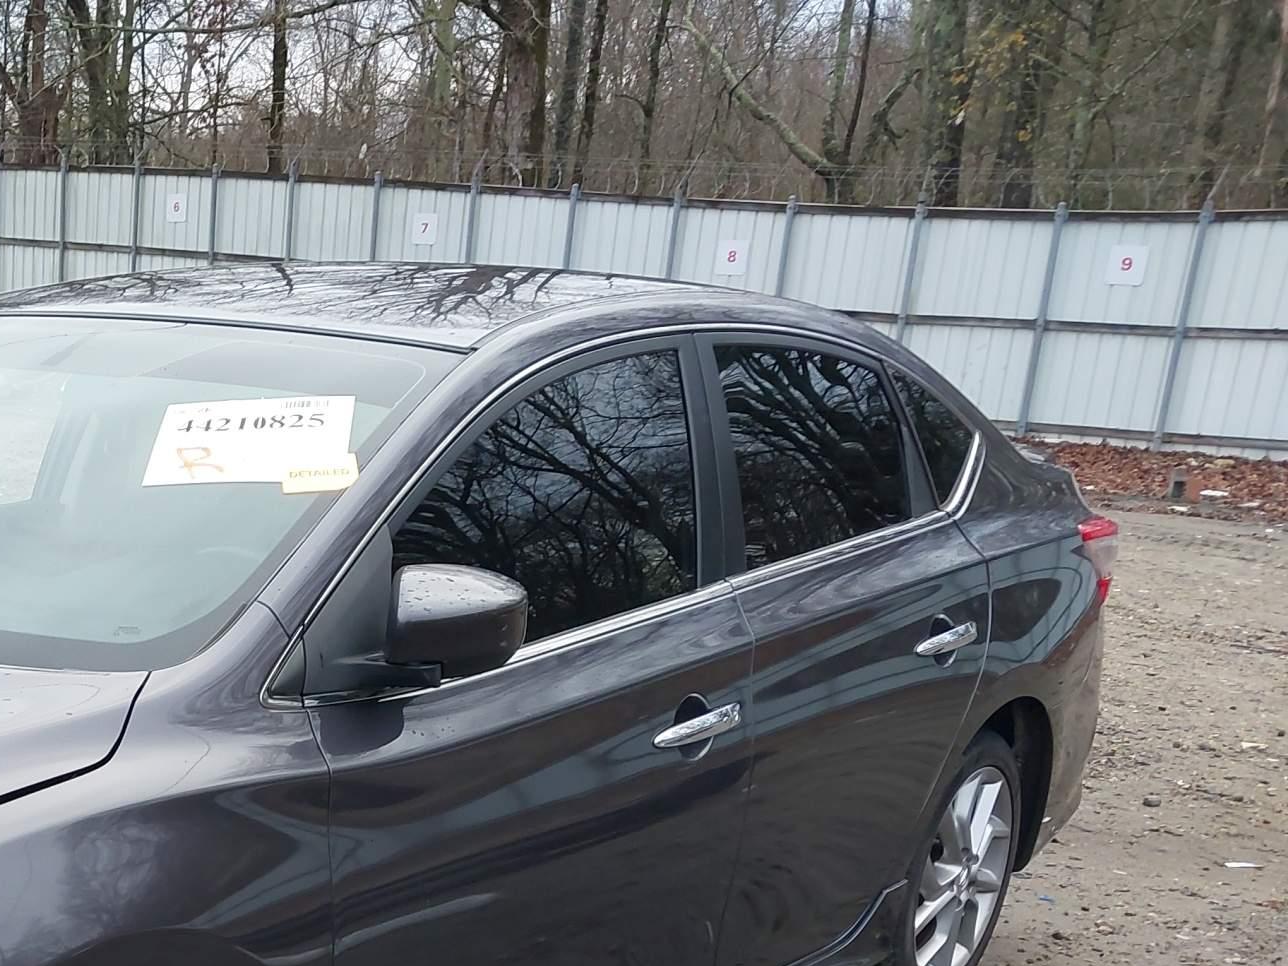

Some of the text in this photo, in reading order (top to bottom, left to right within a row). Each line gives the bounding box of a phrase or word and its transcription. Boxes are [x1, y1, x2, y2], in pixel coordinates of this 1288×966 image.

[173, 202, 180, 212] 6
[421, 223, 429, 233] 7
[727, 250, 737, 263] 8
[1120, 257, 1133, 271] 9
[177, 413, 326, 433] 44210825
